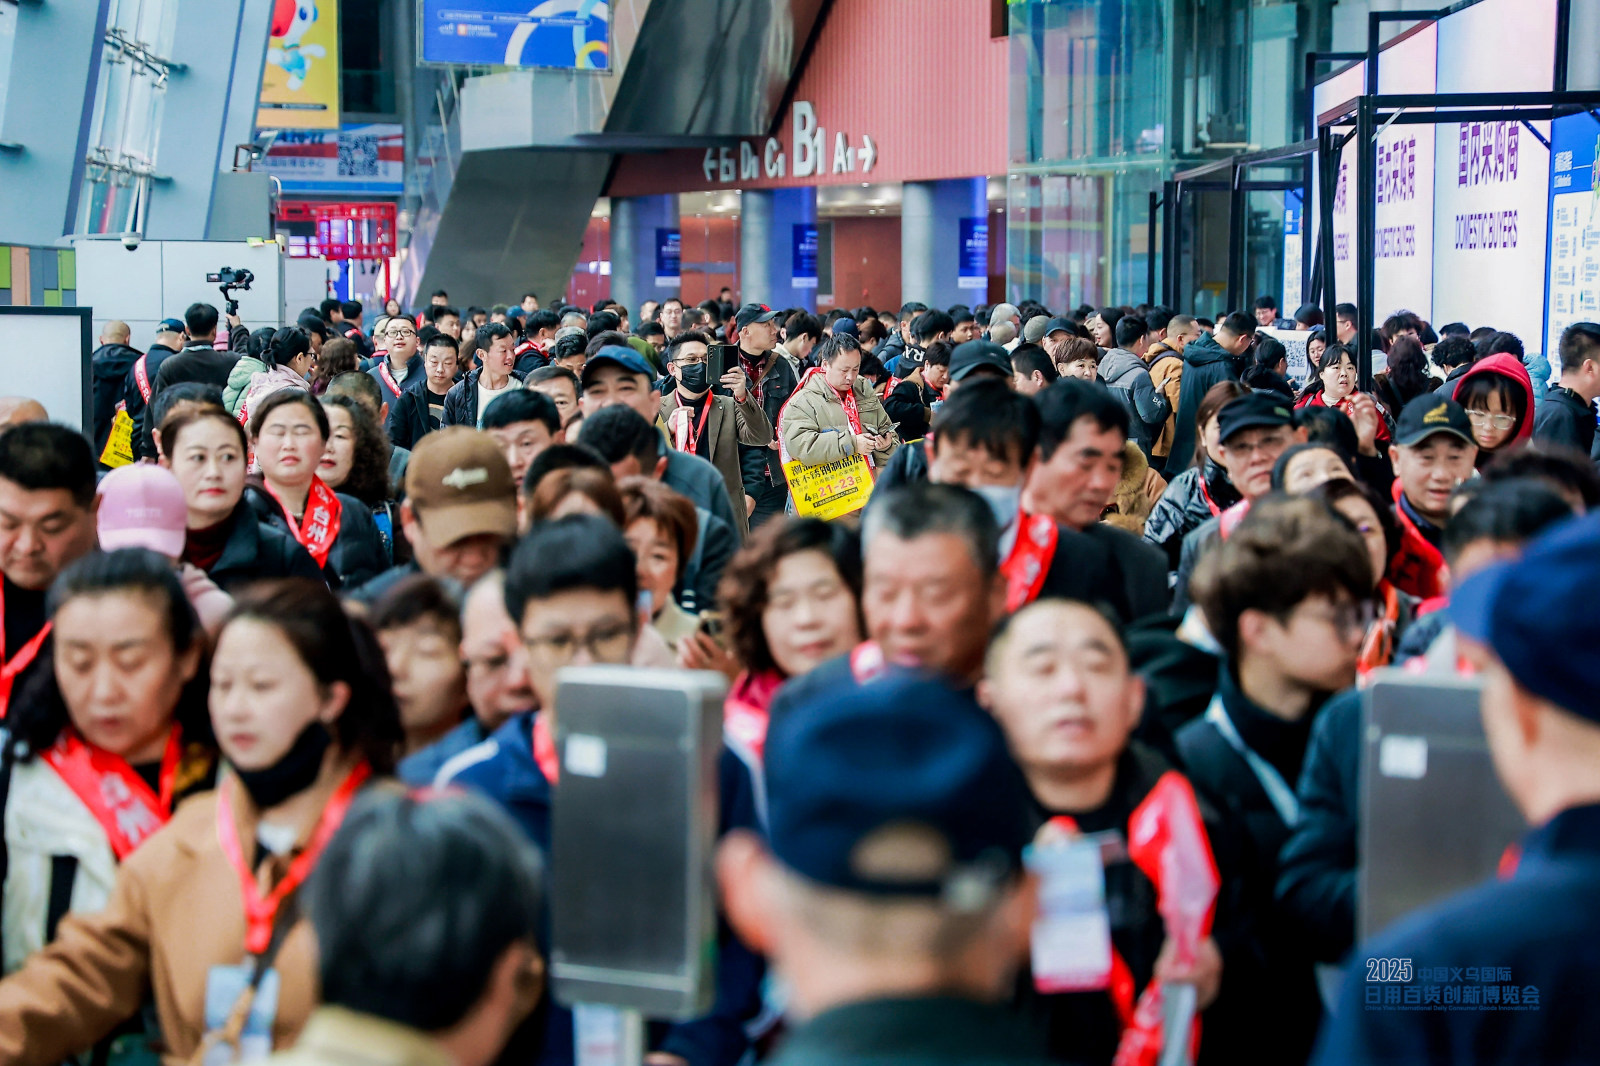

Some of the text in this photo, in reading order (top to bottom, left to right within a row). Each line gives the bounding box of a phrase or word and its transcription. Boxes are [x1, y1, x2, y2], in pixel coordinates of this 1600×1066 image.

[792, 100, 827, 178] B1
[832, 132, 856, 175] A1
[1458, 120, 1519, 188] 国内采购商
[1455, 208, 1518, 250] DOMESTIC BUYERS
